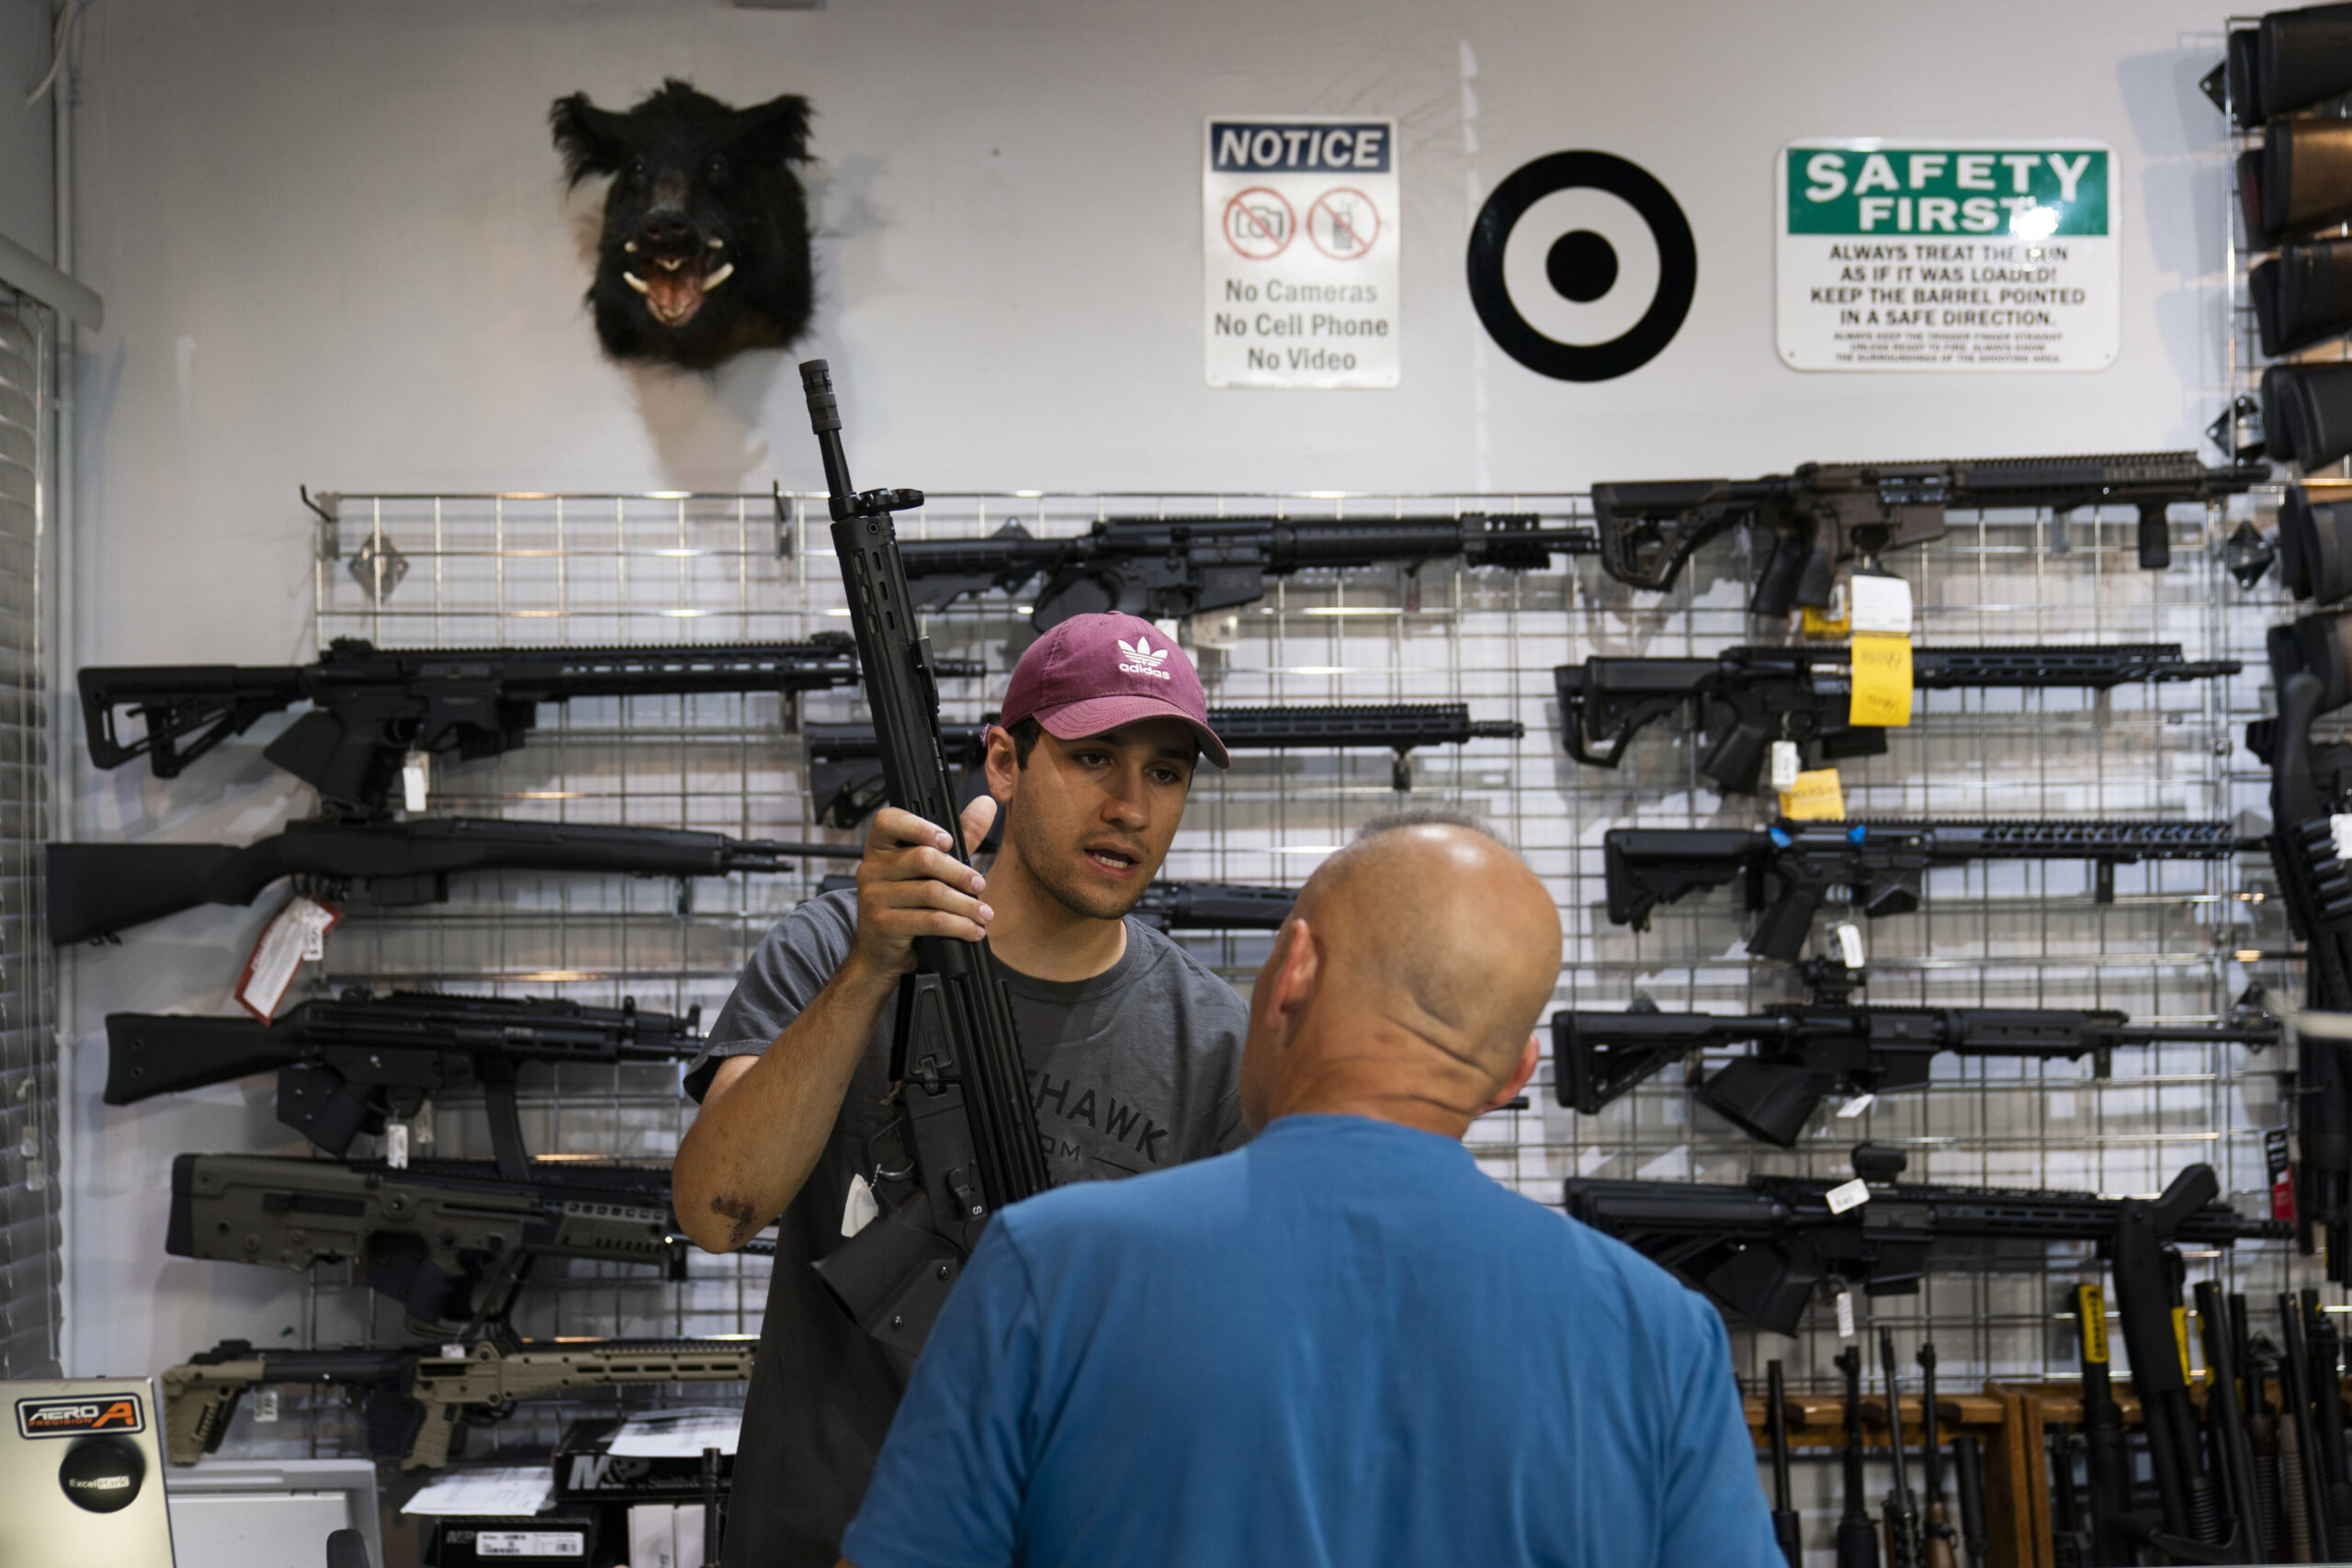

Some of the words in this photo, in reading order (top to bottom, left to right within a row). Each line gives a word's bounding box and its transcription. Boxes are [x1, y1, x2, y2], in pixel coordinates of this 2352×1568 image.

[1217, 130, 1384, 167] NOTICE
[1804, 153, 2091, 202] SAFETY
[1859, 197, 2036, 231] FIRST
[1830, 244, 1907, 261] ALWAYS
[1916, 244, 1974, 261] TREAT
[1841, 266, 1865, 283] AS
[1872, 266, 1890, 282] IF
[1897, 266, 1913, 282] IT
[1921, 266, 1963, 283] WAS
[1972, 266, 2057, 283] LOADED!
[1226, 279, 1258, 302] No
[1266, 279, 1377, 303] Cameras
[1811, 288, 1862, 304] KEEP
[1870, 288, 1906, 304] THE
[1913, 288, 1993, 305] BARREL
[1999, 288, 2086, 305] POINTED
[1215, 313, 1247, 336] No
[1255, 313, 1303, 336] Cell
[1311, 313, 1389, 336] Phone
[1840, 309, 1860, 325] IN
[1866, 309, 1880, 325] A
[1885, 309, 1937, 326] SAFE
[1942, 310, 2057, 326] DIRECTION.
[1248, 347, 1280, 370] No
[1287, 347, 1356, 370] Video
[1118, 662, 1170, 680] adidas
[1027, 1069, 1170, 1165] HAWK
[28, 1417, 93, 1427] PRECISION
[29, 1404, 99, 1421] AERO
